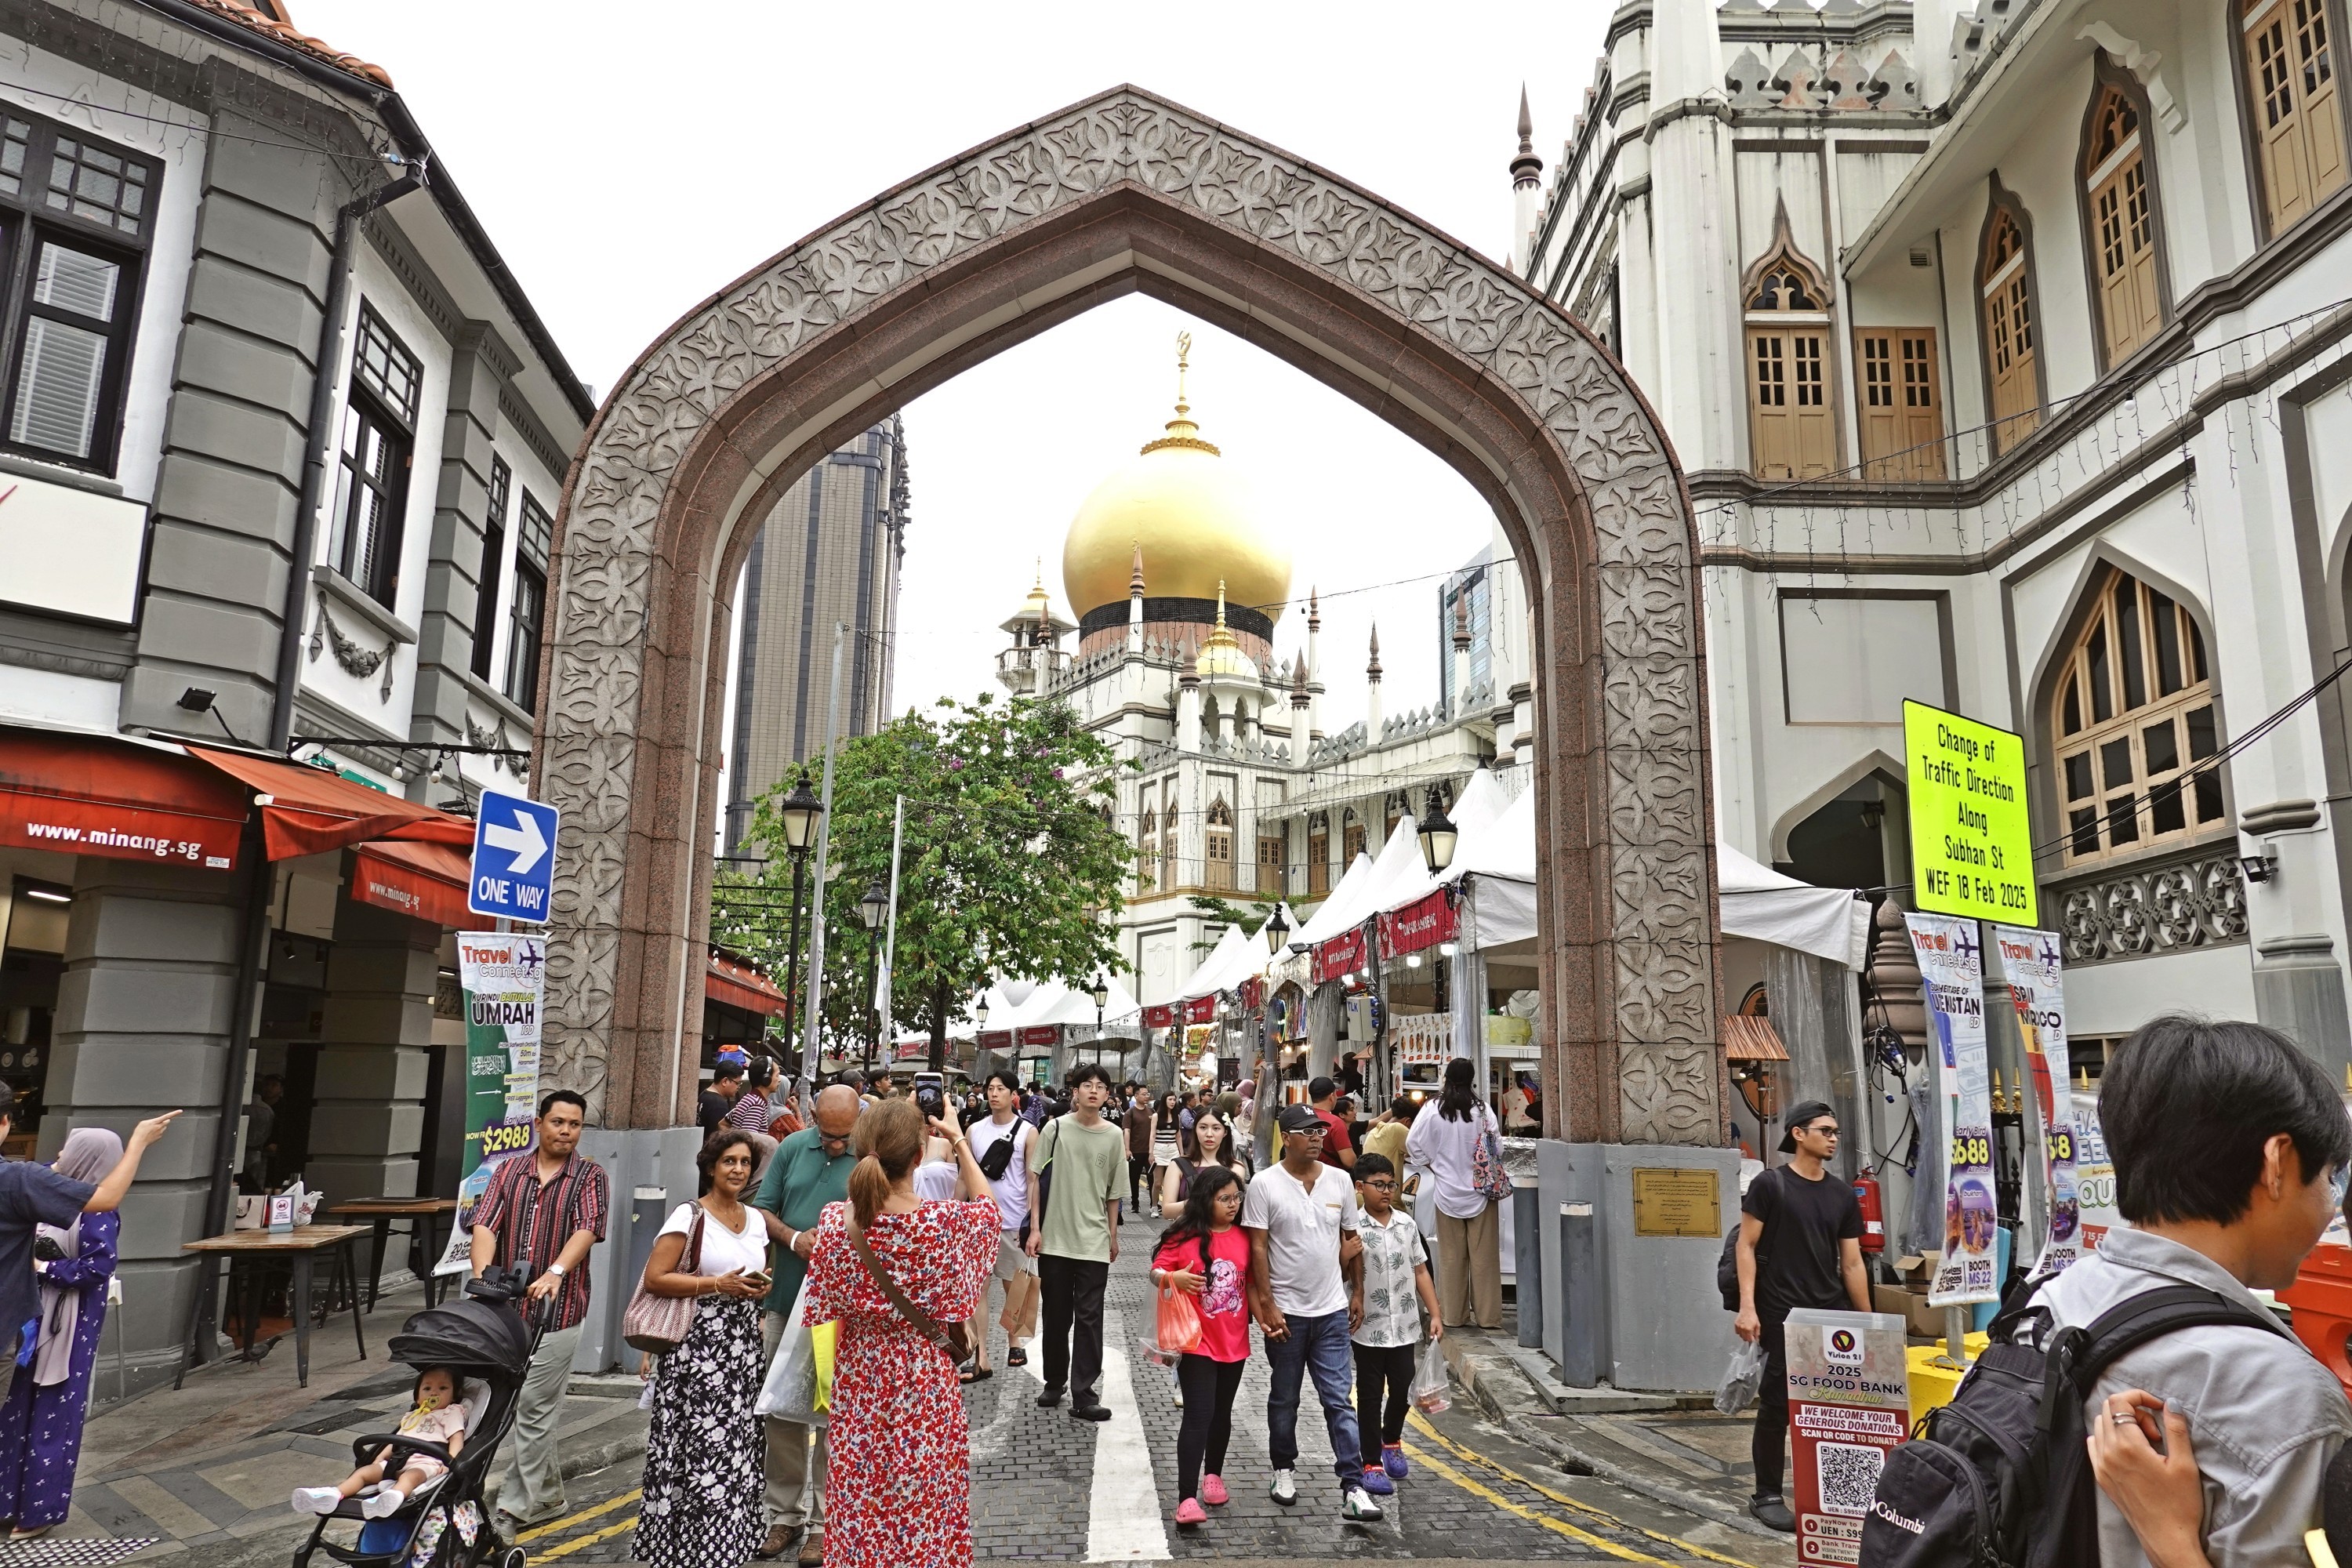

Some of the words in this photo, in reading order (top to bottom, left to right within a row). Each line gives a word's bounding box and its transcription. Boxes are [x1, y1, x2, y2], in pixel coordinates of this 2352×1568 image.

[1938, 724, 1978, 762] Change
[1985, 740, 1994, 763] of
[1922, 755, 1961, 788] Traffic
[1966, 768, 2014, 803] Direction
[1958, 801, 1987, 837] Along
[27, 822, 201, 860] www.minang.sg
[1945, 835, 1986, 866] Subhan
[1991, 845, 2004, 870] St
[478, 876, 509, 904] ONE
[516, 884, 545, 910] WAY
[1926, 868, 1950, 896] WEF
[1957, 874, 1969, 899] 18
[1975, 877, 1994, 904] Feb
[2000, 883, 2027, 909] 2025
[1911, 930, 1948, 951] Travel
[463, 946, 512, 964] Travel
[1999, 940, 2034, 961] Travel
[480, 964, 543, 983] Connect.sg
[501, 992, 535, 1002] BAITULLAH
[472, 1003, 535, 1025] UMRAH
[521, 1025, 534, 1036] 10D
[505, 1116, 519, 1126] Early
[521, 1114, 532, 1123] Bird
[2072, 1109, 2101, 1136] HA
[1973, 1126, 1987, 1135] Bird
[466, 1131, 479, 1141] NOW
[483, 1124, 530, 1156] $2988
[2078, 1178, 2116, 1208] QU
[451, 1243, 462, 1254] 20
[445, 1254, 456, 1264] 25
[1969, 1260, 1991, 1272] BOOTH
[1969, 1272, 1980, 1285] MS
[1982, 1271, 1991, 1283] 22
[1828, 1351, 1850, 1360] Vision
[1827, 1365, 1862, 1377] 2025
[1789, 1375, 1808, 1386] SG
[1813, 1377, 1856, 1391] FOOD
[1860, 1381, 1904, 1396] BANK
[1808, 1385, 1884, 1404] Ramadhan
[1805, 1406, 1818, 1416] WE
[1820, 1408, 1864, 1421] WELCOME
[1867, 1412, 1892, 1423] YOUR
[1798, 1416, 1846, 1428] GENEROUS
[1848, 1421, 1900, 1434] DONATIONS
[1801, 1428, 1821, 1438] SCAN
[1823, 1431, 1833, 1439] QR
[1835, 1432, 1856, 1442] CODE
[1857, 1434, 1867, 1443] TO
[1867, 1435, 1898, 1446] DONATE
[1820, 1518, 1848, 1526] PayNow
[1820, 1526, 1838, 1536] UEN
[1846, 1530, 1863, 1538] S99
